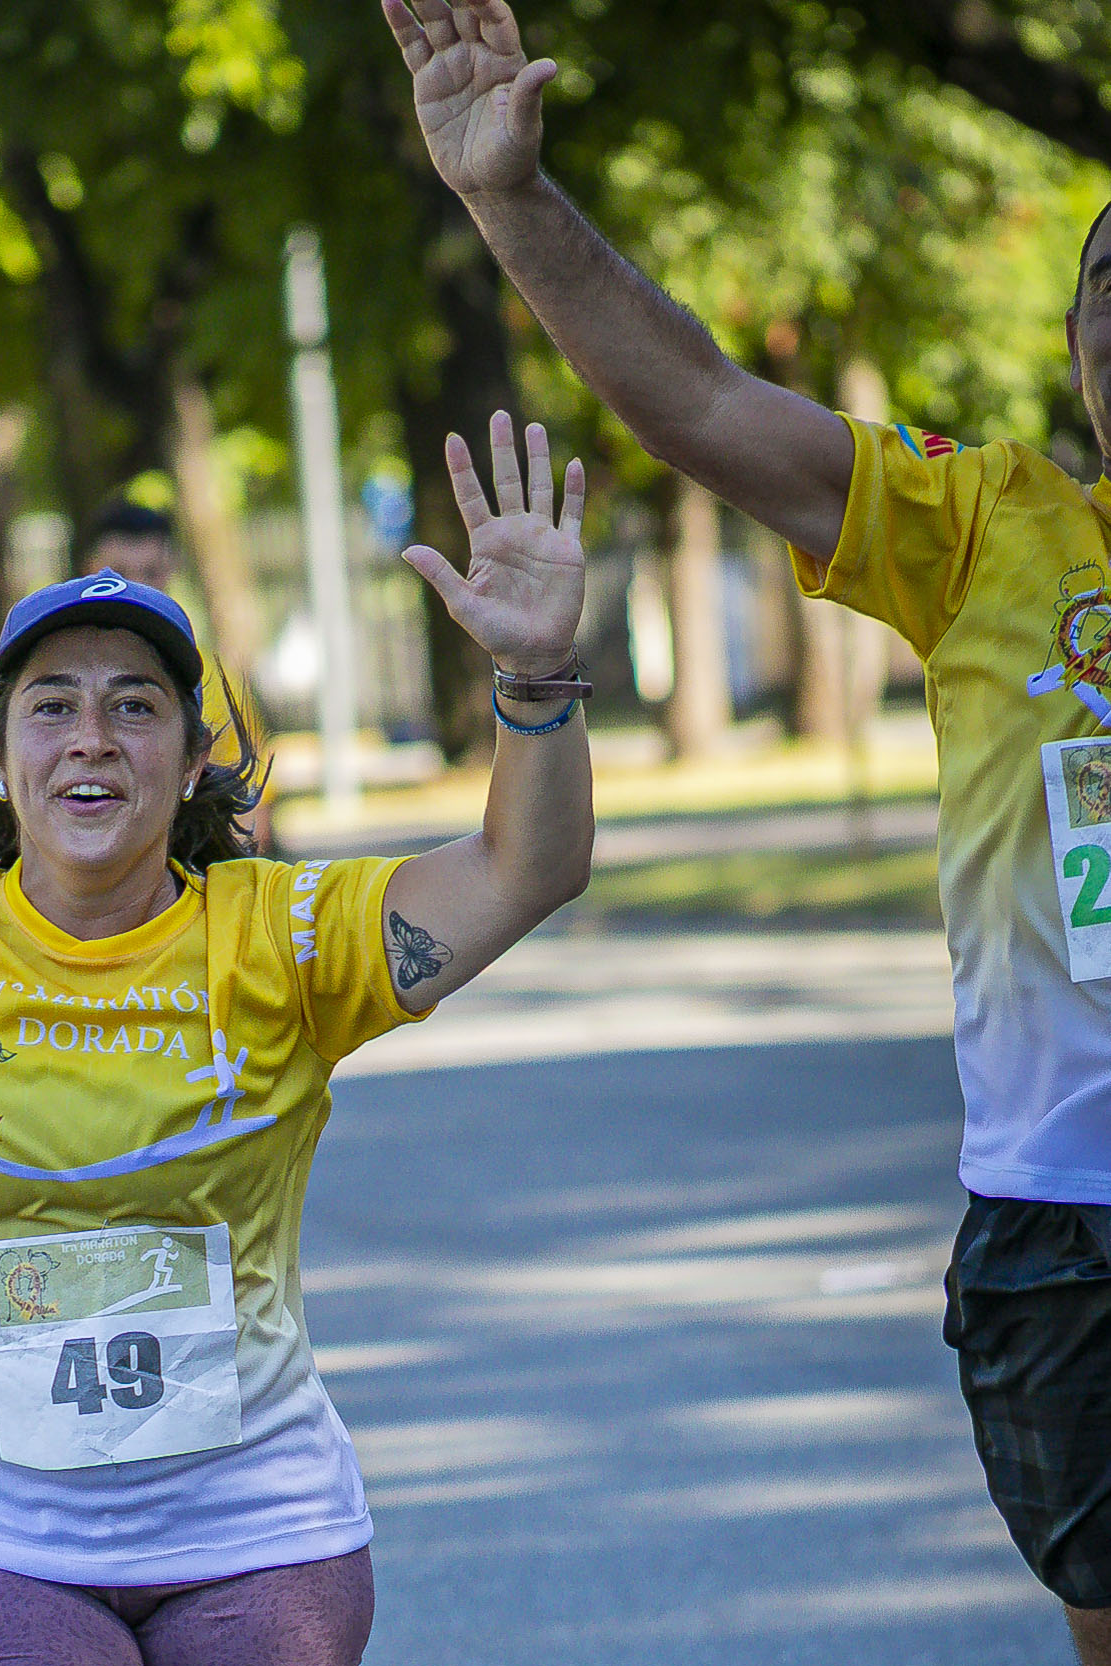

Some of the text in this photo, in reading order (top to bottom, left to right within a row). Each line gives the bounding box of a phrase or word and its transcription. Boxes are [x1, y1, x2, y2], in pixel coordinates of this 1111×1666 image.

[16, 1016, 191, 1060] DORADA
[76, 1249, 126, 1265] DORADA
[51, 1331, 165, 1416] 49
